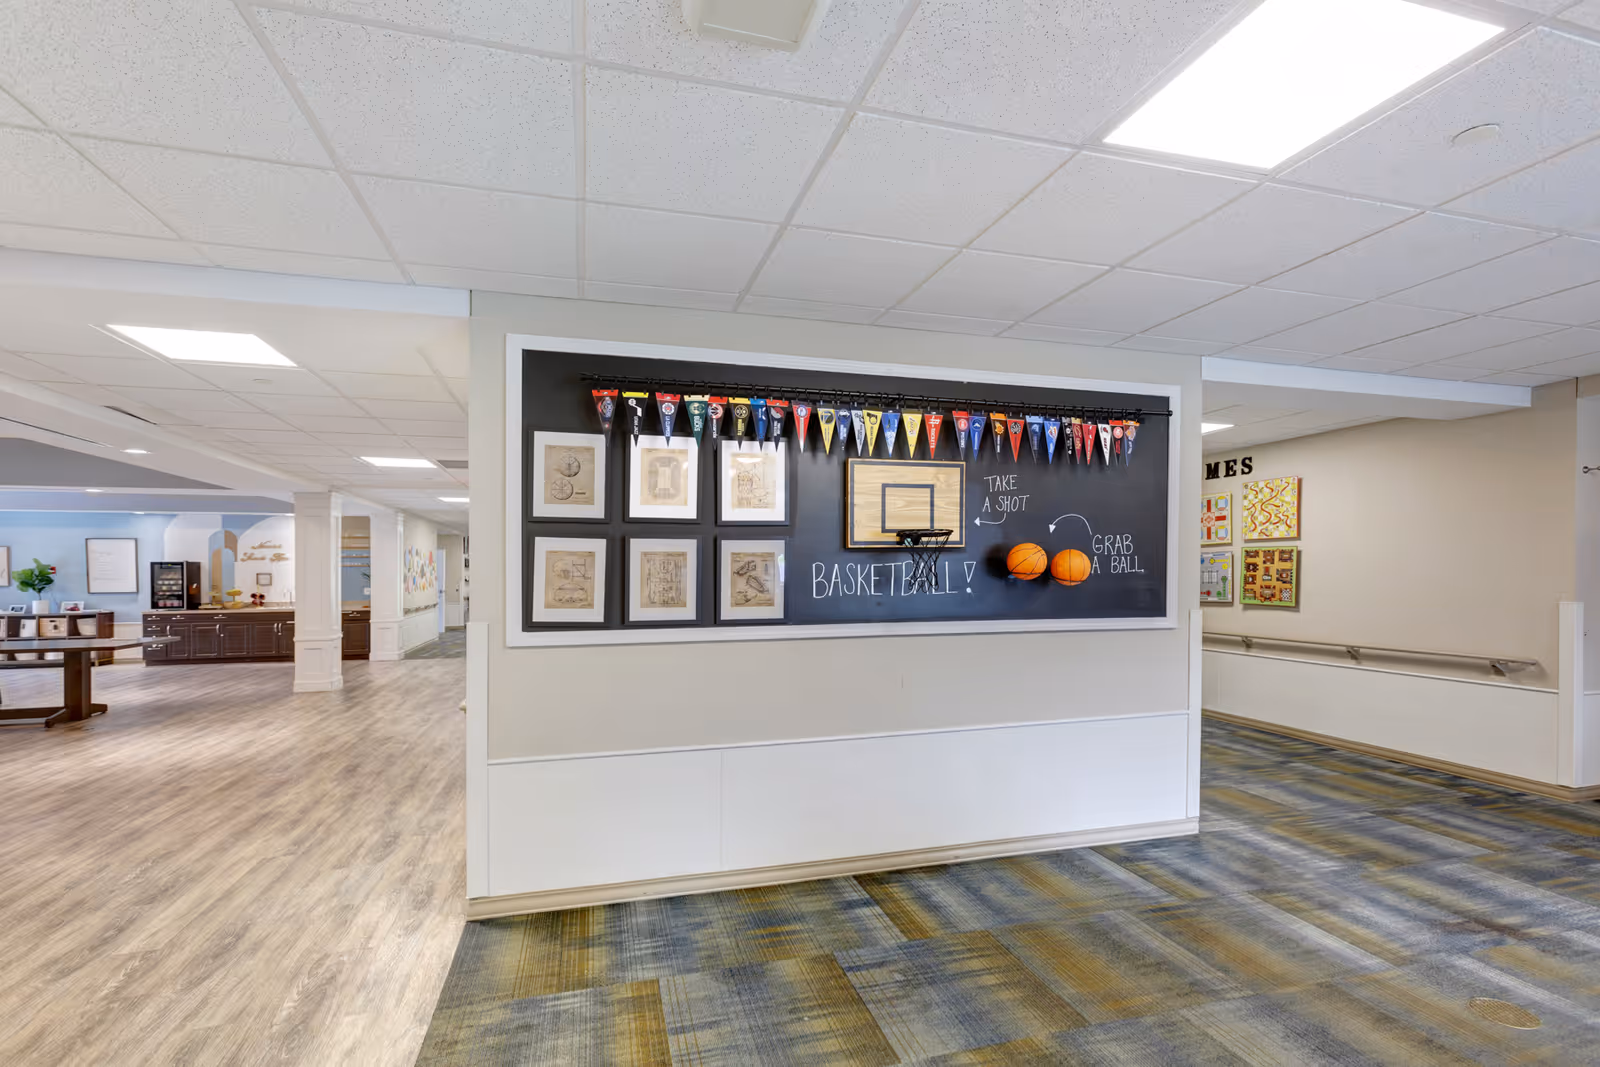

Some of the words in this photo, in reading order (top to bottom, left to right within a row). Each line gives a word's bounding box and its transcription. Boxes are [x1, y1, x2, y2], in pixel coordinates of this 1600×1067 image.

[984, 475, 1018, 492] TAKE
[982, 497, 991, 512] A
[996, 495, 1030, 512] SHOT
[1092, 534, 1134, 555] GRAB
[1091, 556, 1100, 574] A
[1111, 556, 1144, 574] BALL
